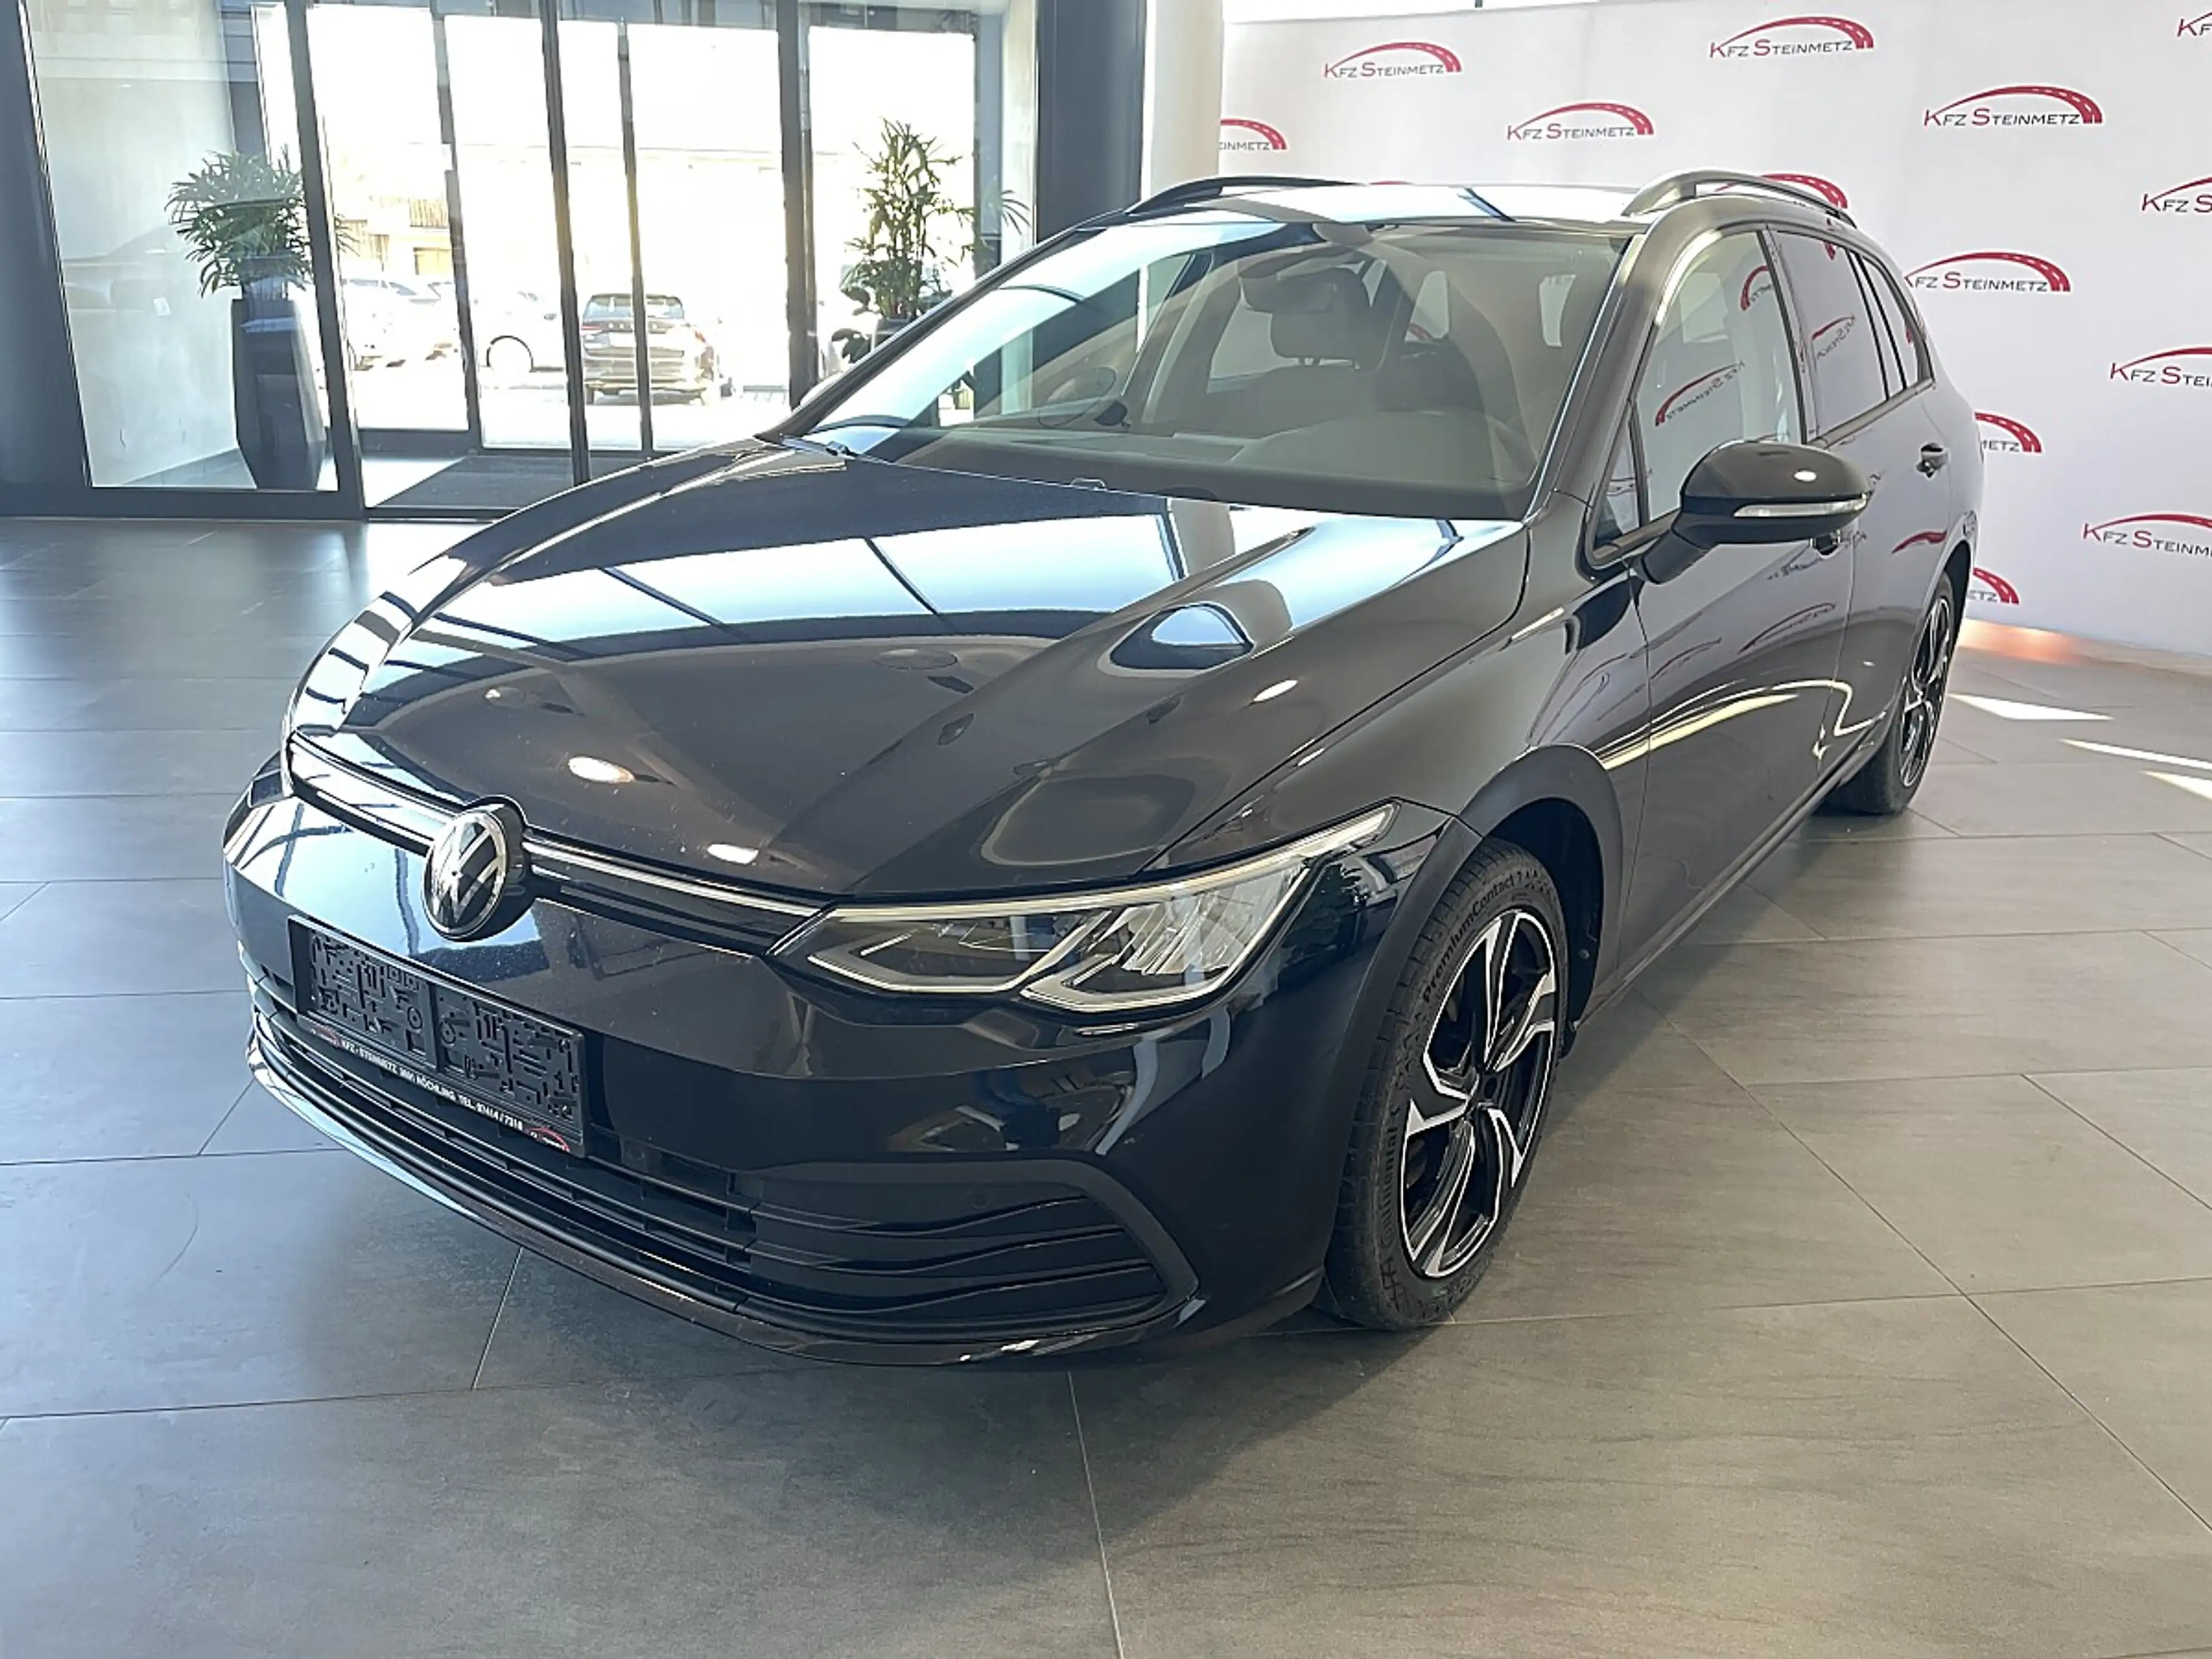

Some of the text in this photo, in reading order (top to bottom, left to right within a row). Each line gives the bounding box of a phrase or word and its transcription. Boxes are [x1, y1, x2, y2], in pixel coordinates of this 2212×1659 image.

[1710, 39, 1853, 58] KFZ STEINMETZ
[1324, 62, 1444, 78] KFZ STEINMETZ
[1924, 108, 2080, 126] KFZ STEINMETZ
[1507, 123, 1634, 140] KFZ STEINMETZ
[2142, 194, 2188, 213] KFZ
[1942, 271, 2047, 292] STEINMETZ
[2109, 362, 2212, 387] KFZ STEI
[2083, 524, 2212, 557] KFZ STEINM
[1423, 873, 1516, 1003] PremiumContact
